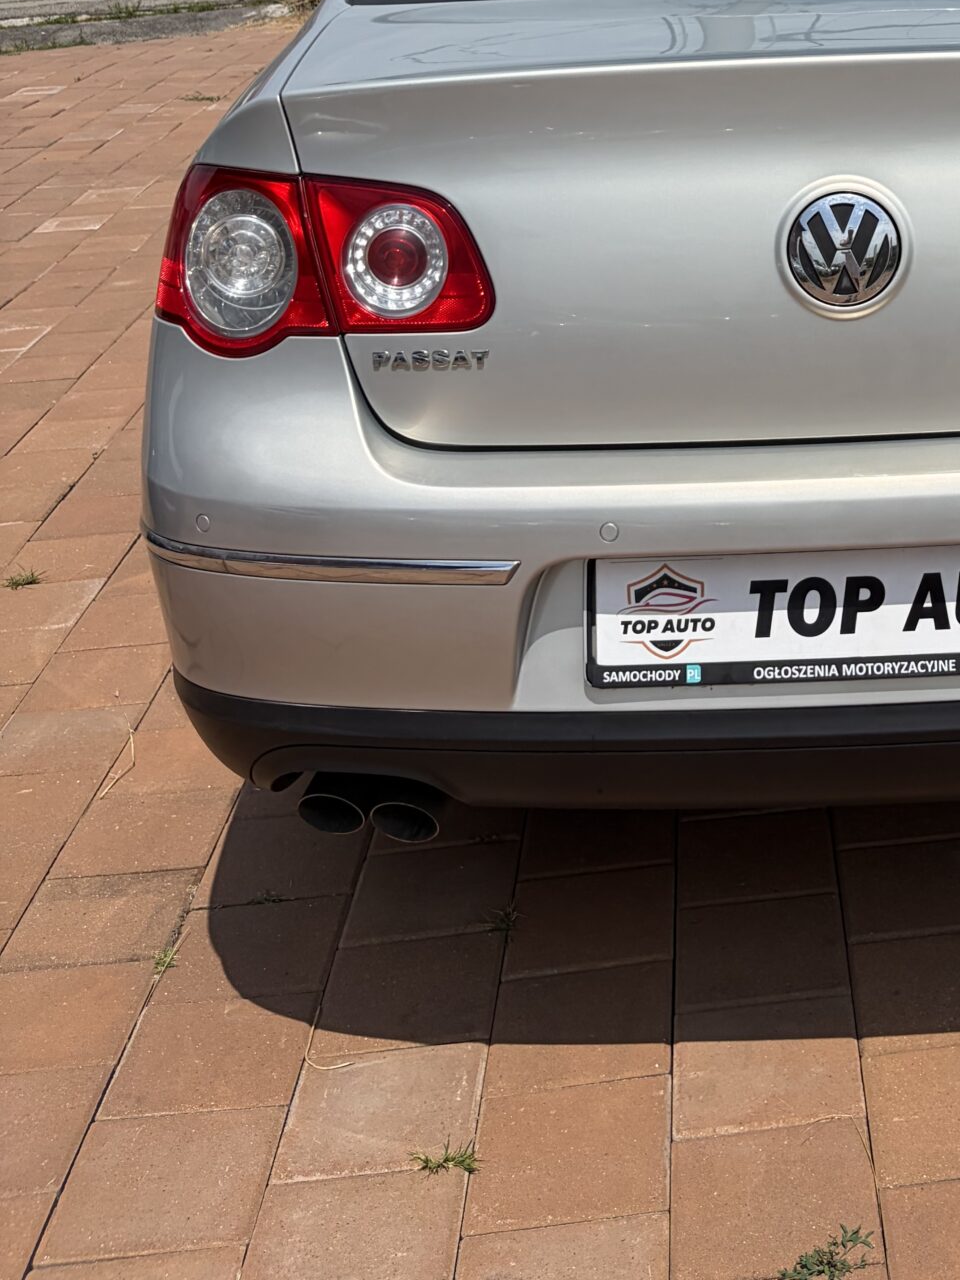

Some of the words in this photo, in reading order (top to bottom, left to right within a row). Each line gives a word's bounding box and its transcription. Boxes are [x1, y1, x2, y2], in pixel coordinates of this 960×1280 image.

[372, 349, 490, 371] PASSAT
[749, 575, 886, 638] TOP
[620, 620, 659, 635] TOP
[661, 617, 716, 634] AUTO
[603, 669, 682, 683] SAMOCHODY
[687, 668, 701, 680] PL
[753, 664, 839, 680] OGŁOSZENIA
[841, 659, 957, 677] MOTORYZACYJNE
